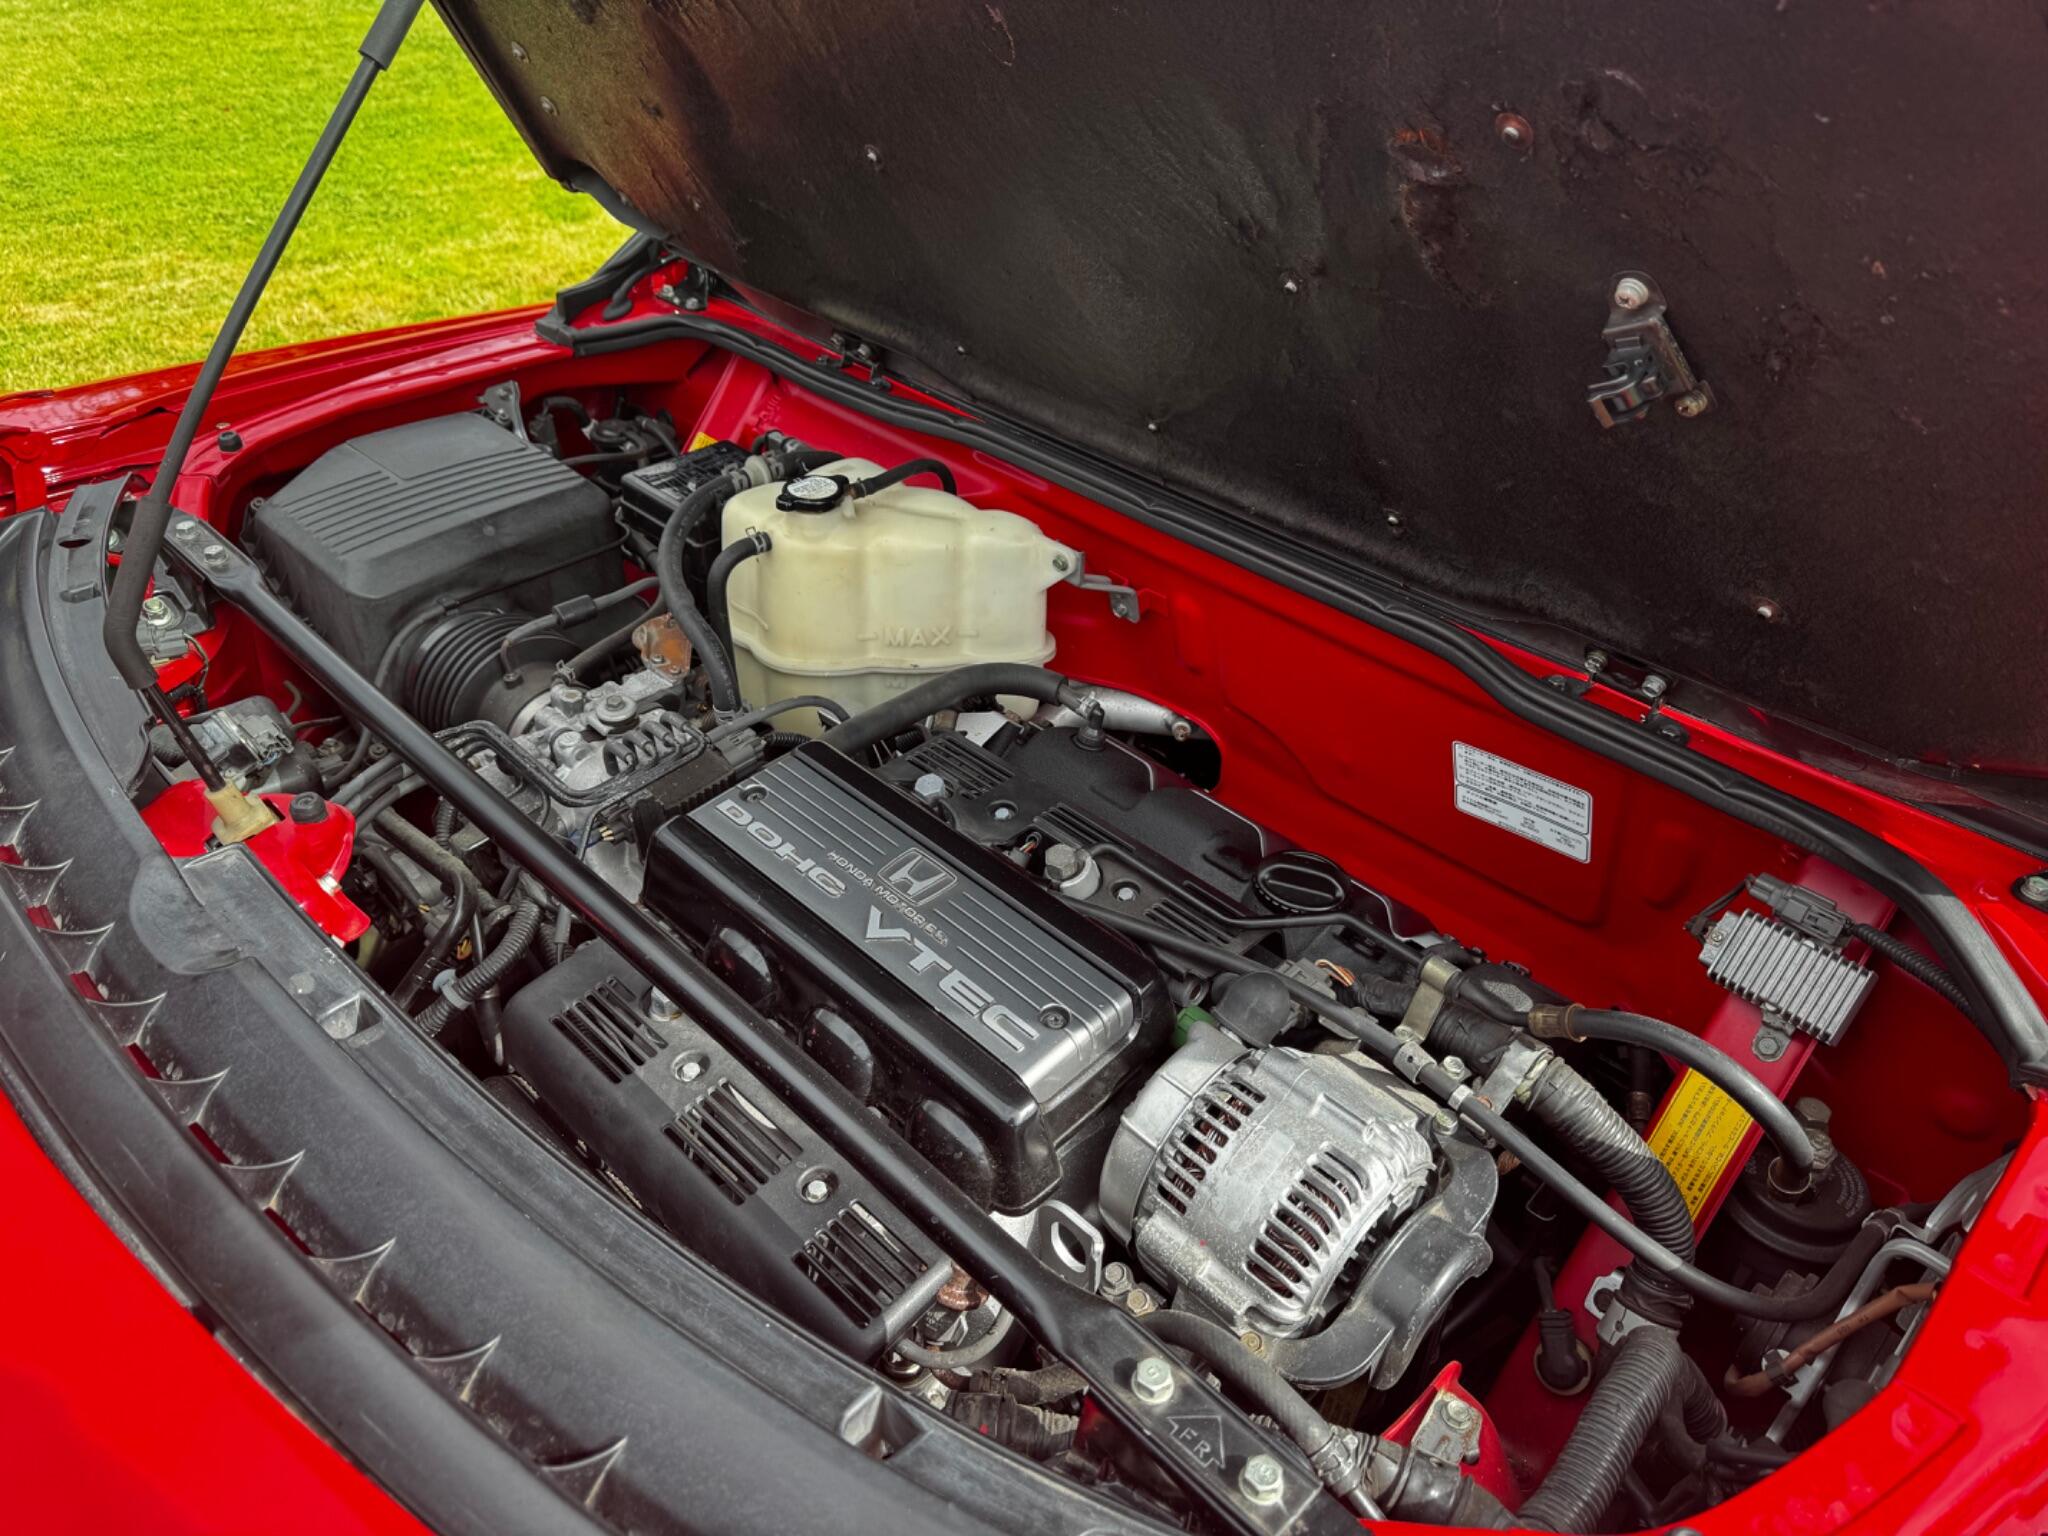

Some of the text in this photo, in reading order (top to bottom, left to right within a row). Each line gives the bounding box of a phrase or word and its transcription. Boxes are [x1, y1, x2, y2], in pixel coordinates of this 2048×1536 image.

[883, 624, 952, 648] MAX
[715, 798, 846, 897] DOHC
[827, 850, 926, 929] HONDA MOTOR
[864, 905, 1040, 1052] VTEC
[1179, 1426, 1211, 1458] FR
